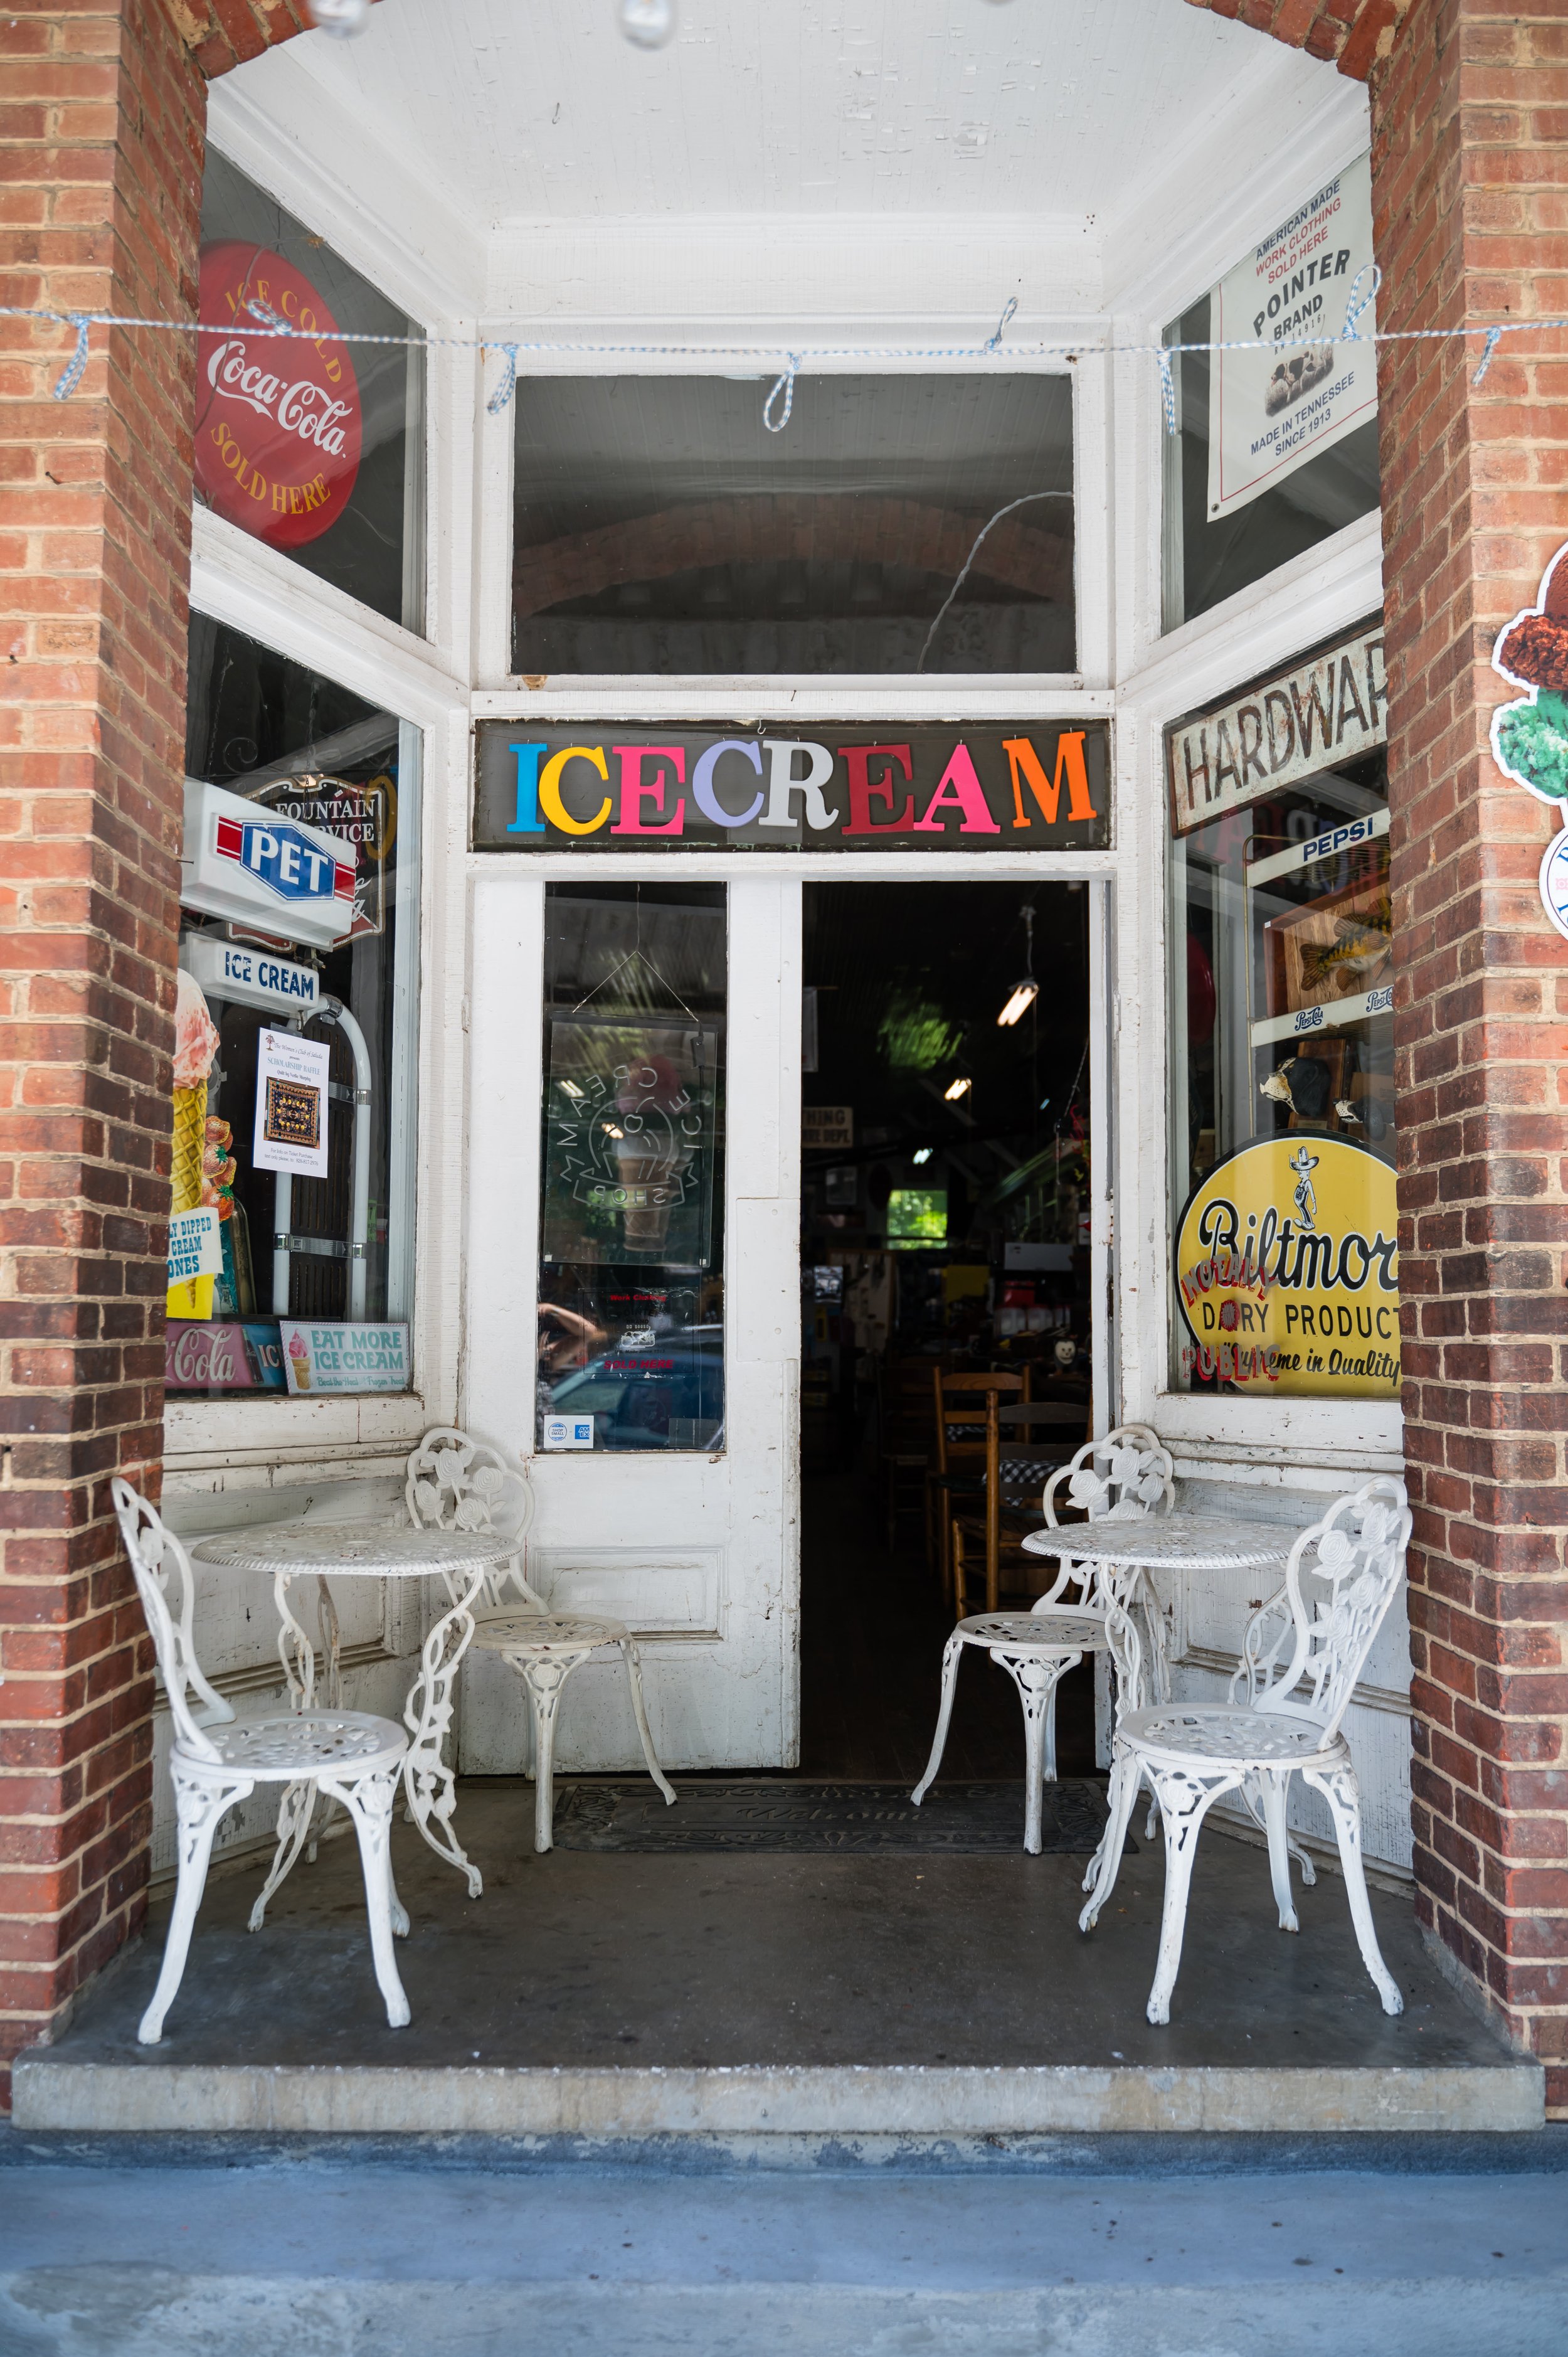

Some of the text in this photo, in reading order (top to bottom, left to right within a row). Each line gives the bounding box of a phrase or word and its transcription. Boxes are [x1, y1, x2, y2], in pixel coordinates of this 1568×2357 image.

[1256, 179, 1340, 261] AMERICAN MADE
[1256, 198, 1340, 277] WORK CLOTHING
[1268, 226, 1328, 284] SOLD HERE
[1253, 250, 1350, 338] POINTER
[225, 279, 342, 383] ICE COLD
[1274, 295, 1323, 341] BRAND
[208, 341, 353, 456] Coca-Cola
[1251, 371, 1354, 455] MADE IN TENNESSEE
[1275, 408, 1331, 456] SINCE 1913
[211, 422, 332, 515] SOLD HERE
[275, 799, 375, 821] FOUNTAIN
[250, 828, 329, 892] PET
[1303, 817, 1373, 862] PEPSI
[225, 950, 314, 1001] ICE CREAM
[267, 1056, 320, 1075] SCHOLARSHIP RAFFLE
[171, 1235, 203, 1257] CREAM
[181, 1216, 212, 1236] DIPPED
[1181, 1253, 1281, 1309] NOTARY
[311, 1330, 402, 1349] EAT MORE
[314, 1351, 404, 1370] ICE CREAM
[1182, 1344, 1281, 1381] PUBLIC
[1306, 1348, 1325, 1372] in
[603, 1359, 674, 1369] SOLD HERE
[736, 1806, 933, 1821] Welcome
